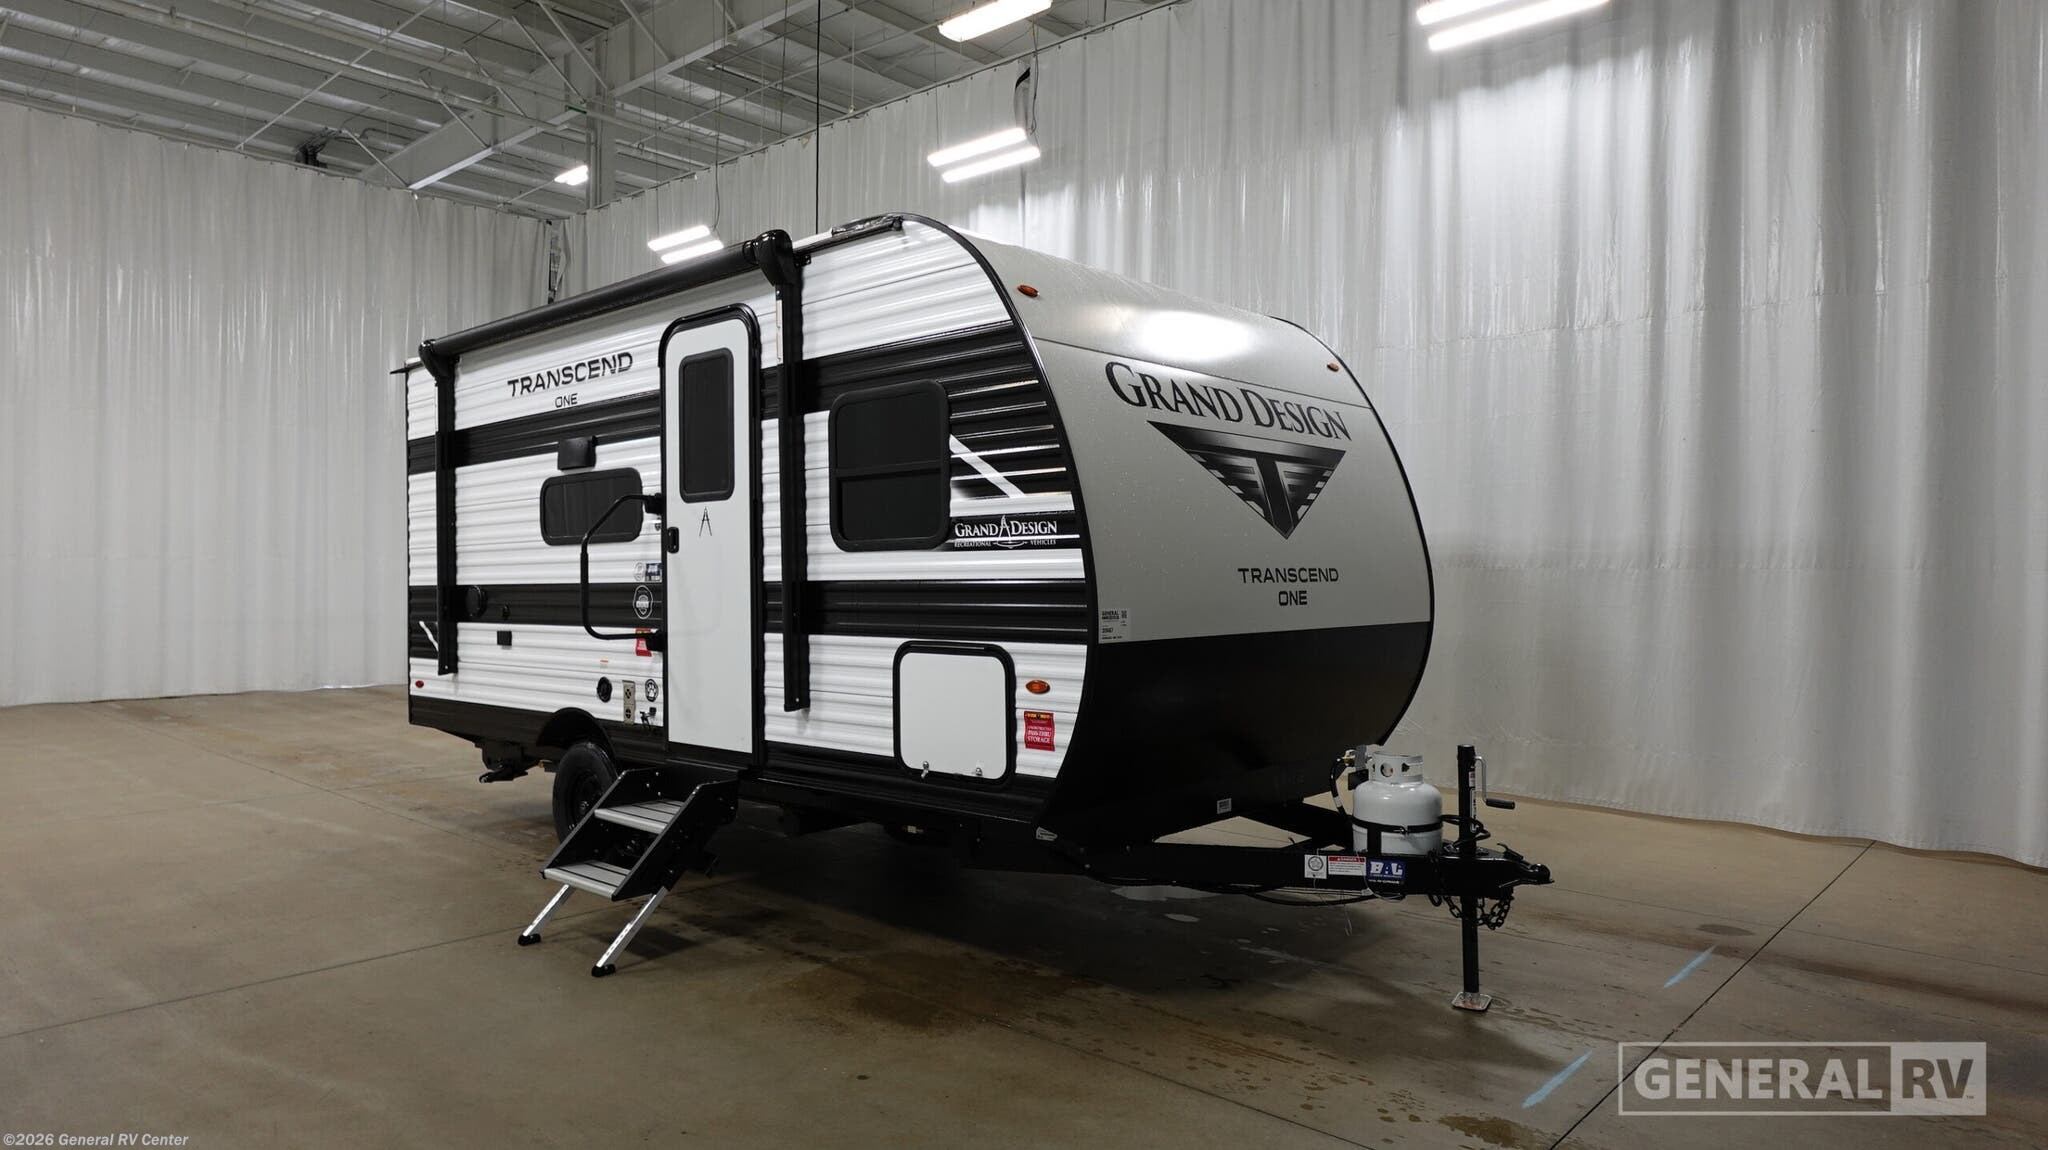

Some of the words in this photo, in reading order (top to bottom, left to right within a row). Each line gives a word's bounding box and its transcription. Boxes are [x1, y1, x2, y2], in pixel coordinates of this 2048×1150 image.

[507, 352, 633, 397] TRANSCEND
[555, 393, 578, 408] ONE
[1105, 361, 1243, 423] GRAND
[1240, 387, 1352, 441] DESIGN
[954, 523, 999, 537] GRAND
[1010, 520, 1057, 535] DESIGN
[1237, 567, 1339, 583] TRANSCEND
[1278, 590, 1308, 606] ONE
